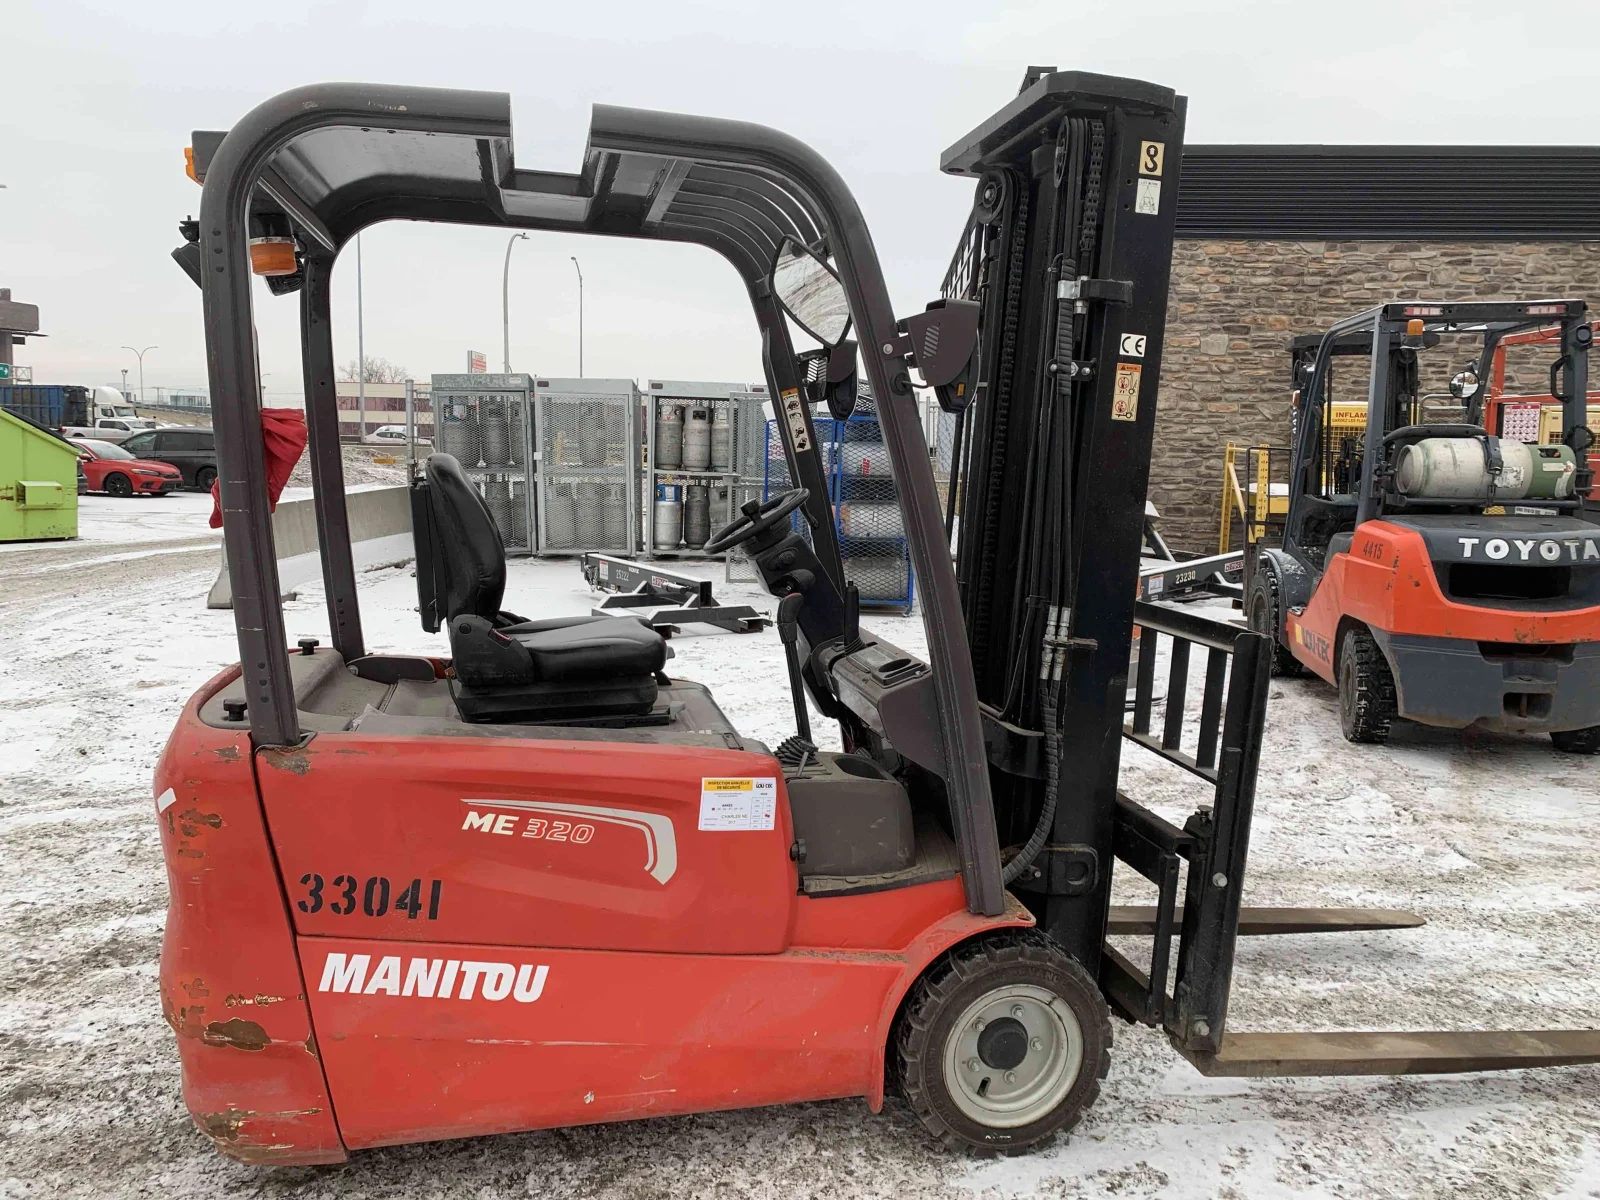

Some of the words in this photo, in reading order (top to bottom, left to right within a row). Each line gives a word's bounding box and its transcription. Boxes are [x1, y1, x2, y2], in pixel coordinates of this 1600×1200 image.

[1362, 539, 1383, 560] 4415
[1457, 536, 1600, 562] TOYOTA
[1175, 570, 1196, 584] 23230
[461, 810, 520, 836] ME
[521, 818, 596, 844] 320
[297, 873, 442, 920] 33041
[318, 952, 550, 1003] MANITOU
